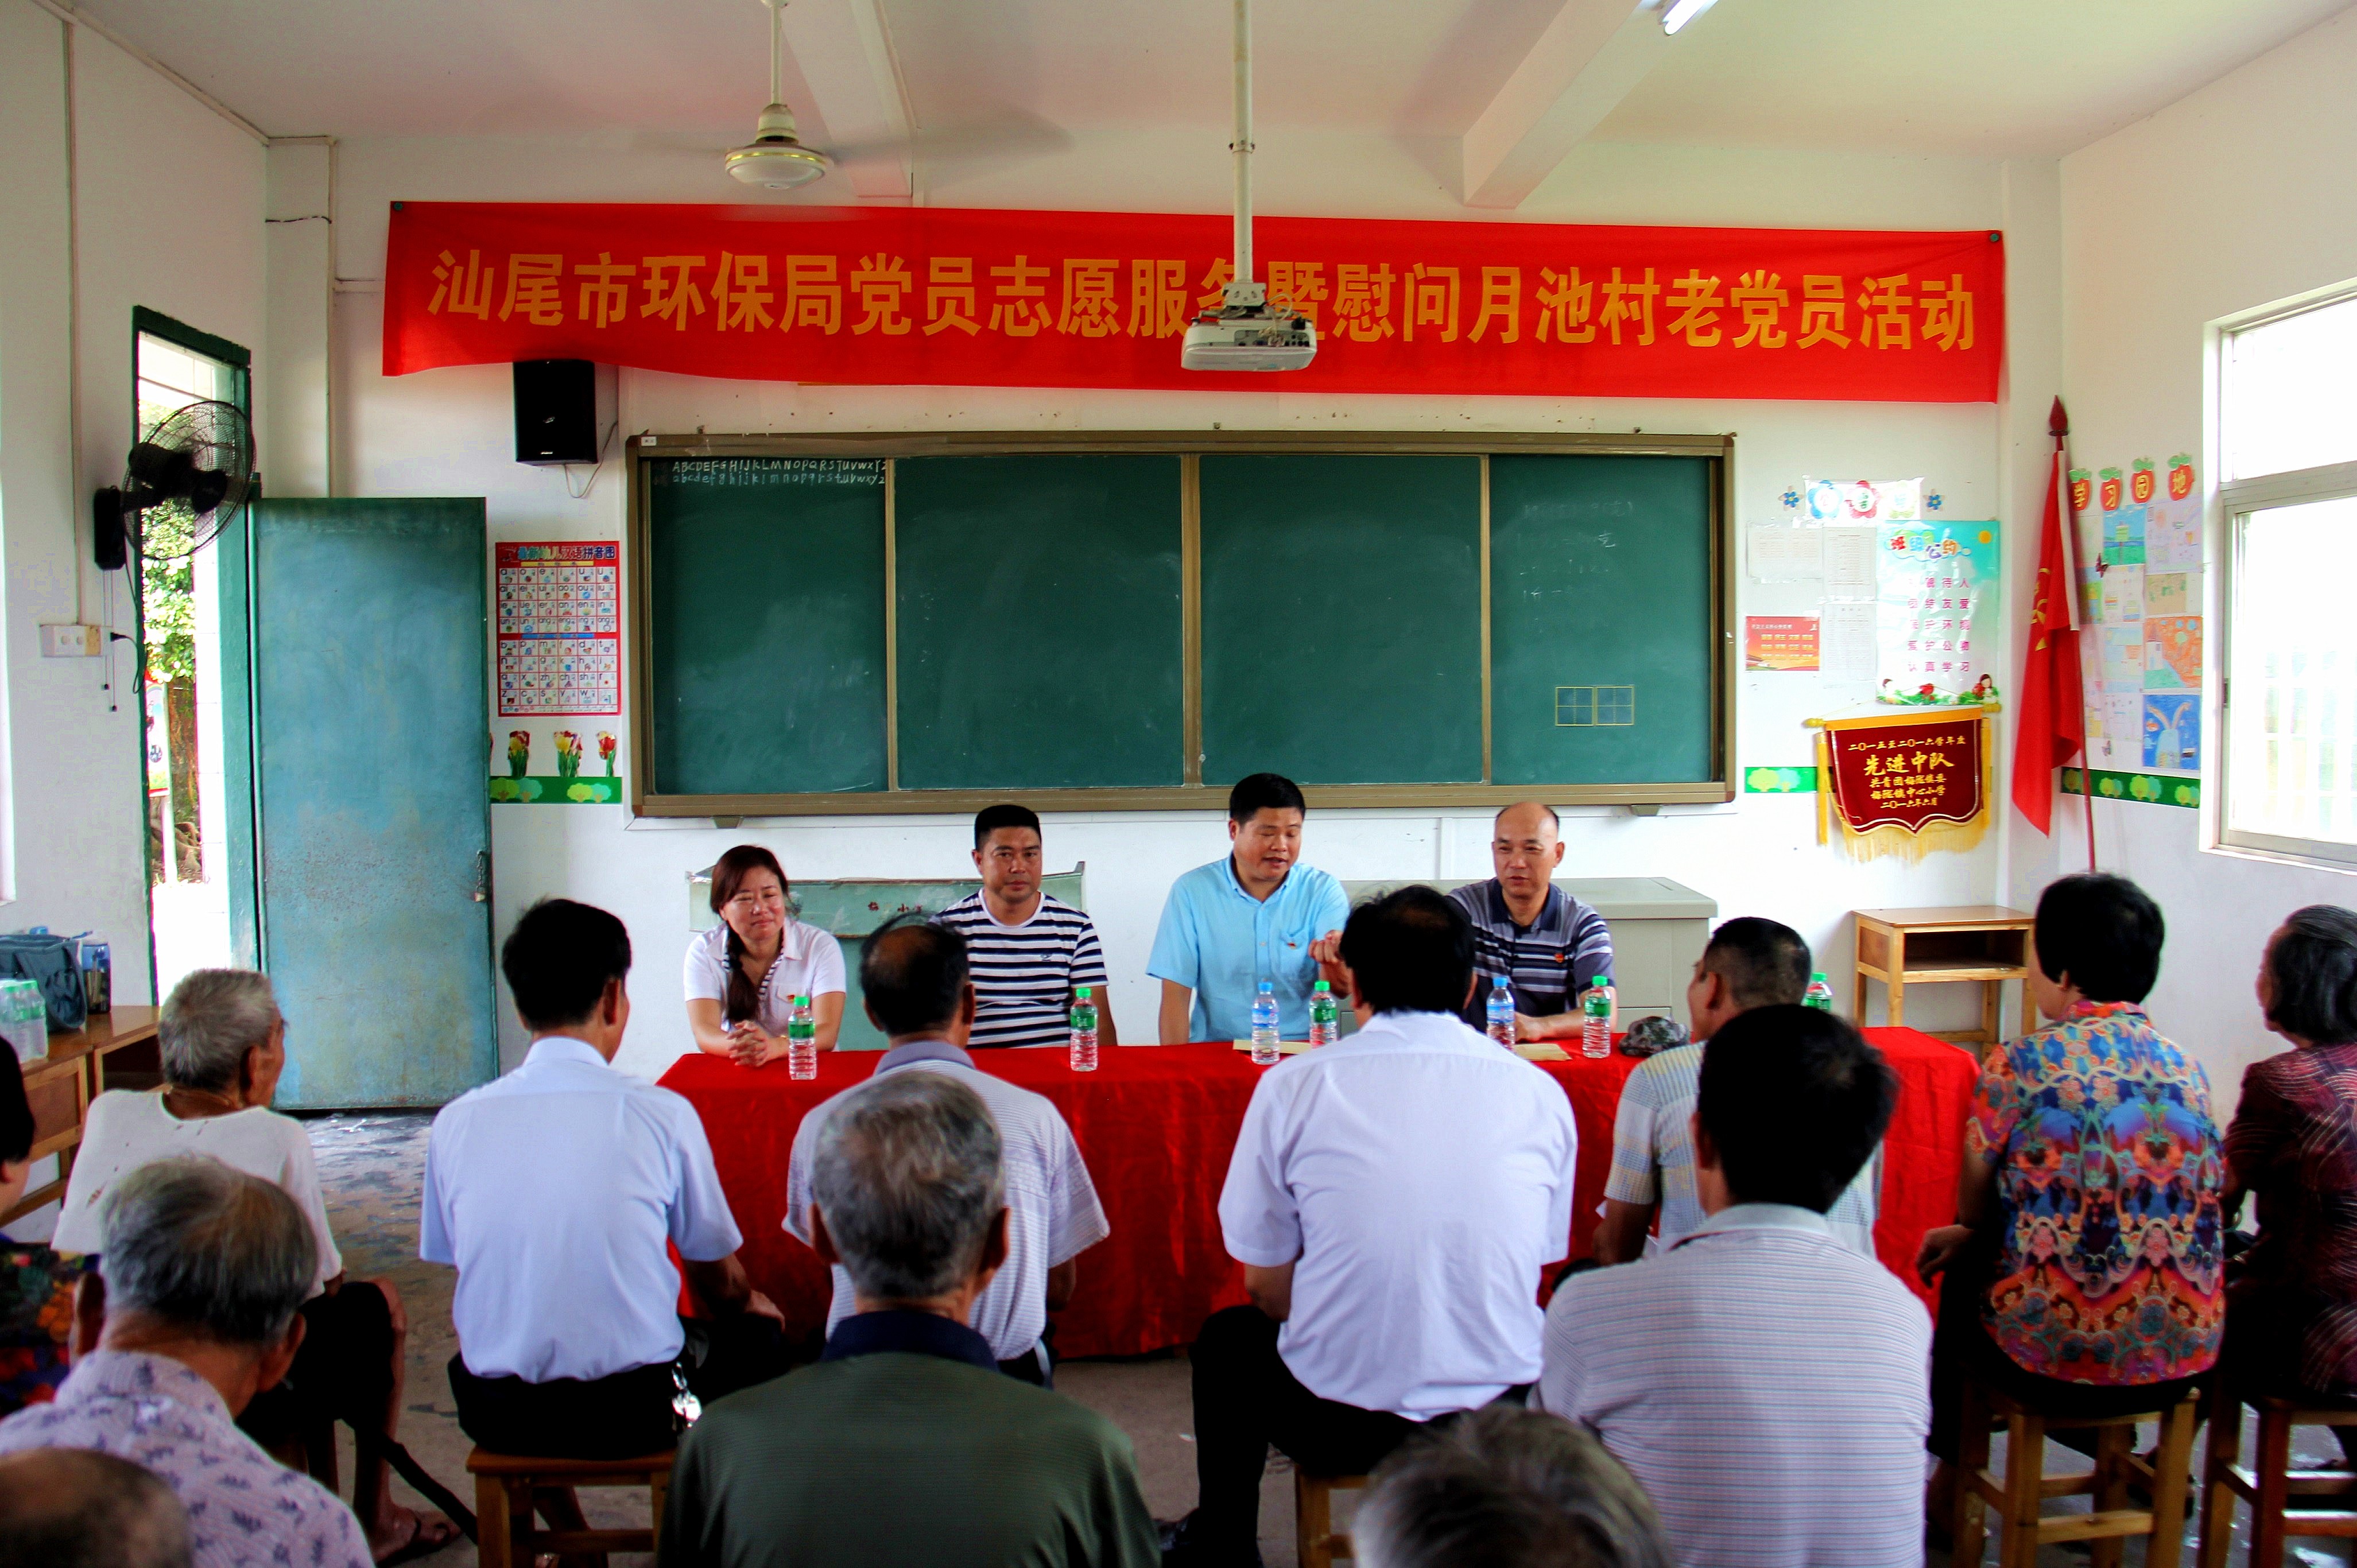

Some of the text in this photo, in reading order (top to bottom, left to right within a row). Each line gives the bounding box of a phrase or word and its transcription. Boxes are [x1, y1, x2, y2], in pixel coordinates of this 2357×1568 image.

[2073, 469, 2187, 508] 学习园地
[1864, 751, 1955, 776] 先进中队
